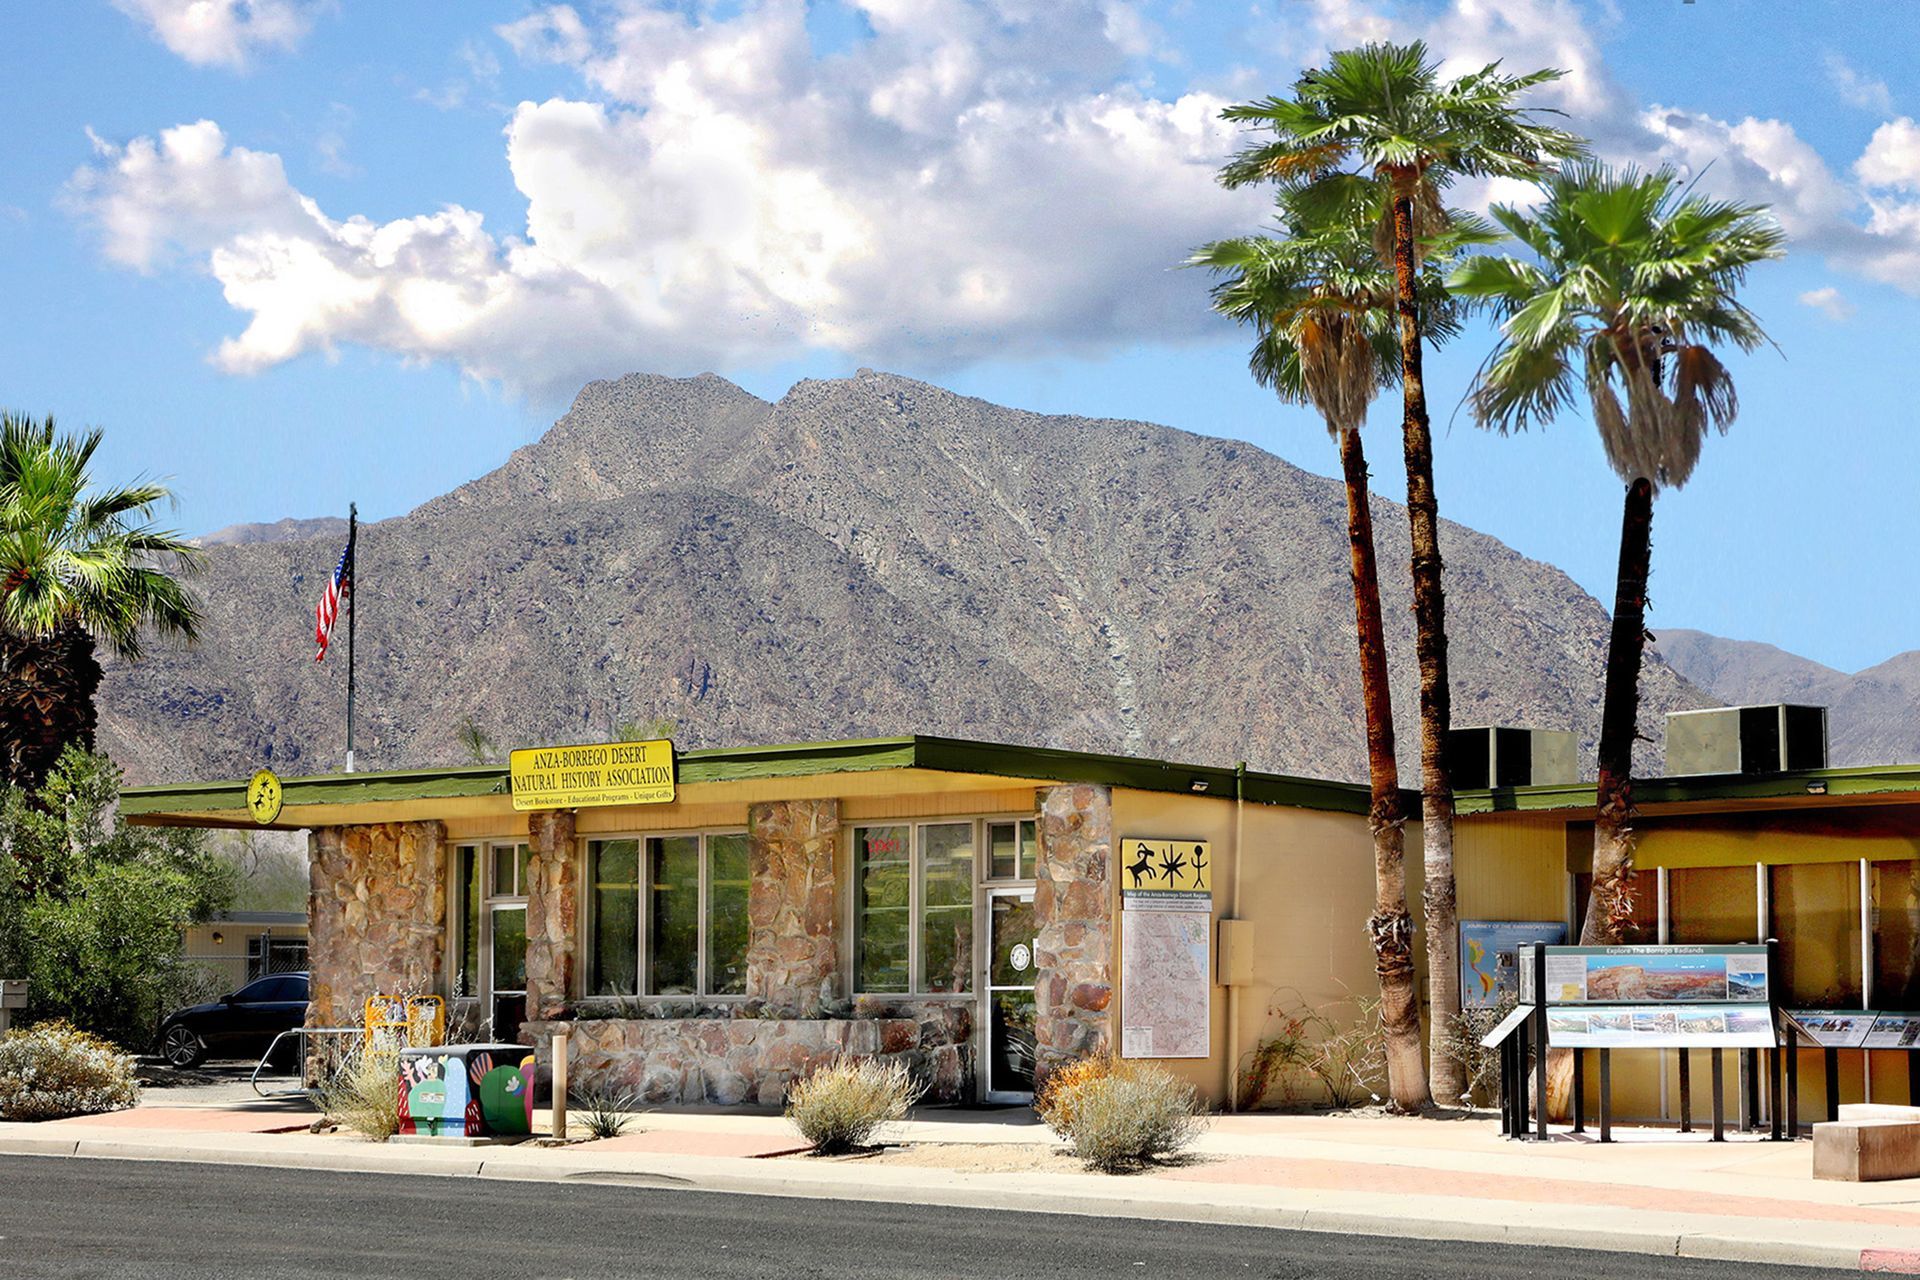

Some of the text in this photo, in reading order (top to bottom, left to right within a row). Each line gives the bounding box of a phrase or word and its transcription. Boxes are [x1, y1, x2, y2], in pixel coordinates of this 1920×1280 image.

[533, 746, 647, 770] ANZA-BORREGO DESERT
[514, 766, 670, 792] NATURAL HISTORY ASSOCIATION
[515, 798, 533, 806] Desert
[535, 797, 563, 805] Bookstore
[567, 793, 600, 803] Educational
[602, 792, 629, 802] Programs
[633, 791, 655, 800] Unique
[656, 789, 672, 798] Gifts
[1606, 947, 1631, 955] Explore
[1646, 947, 1673, 955] Borrego
